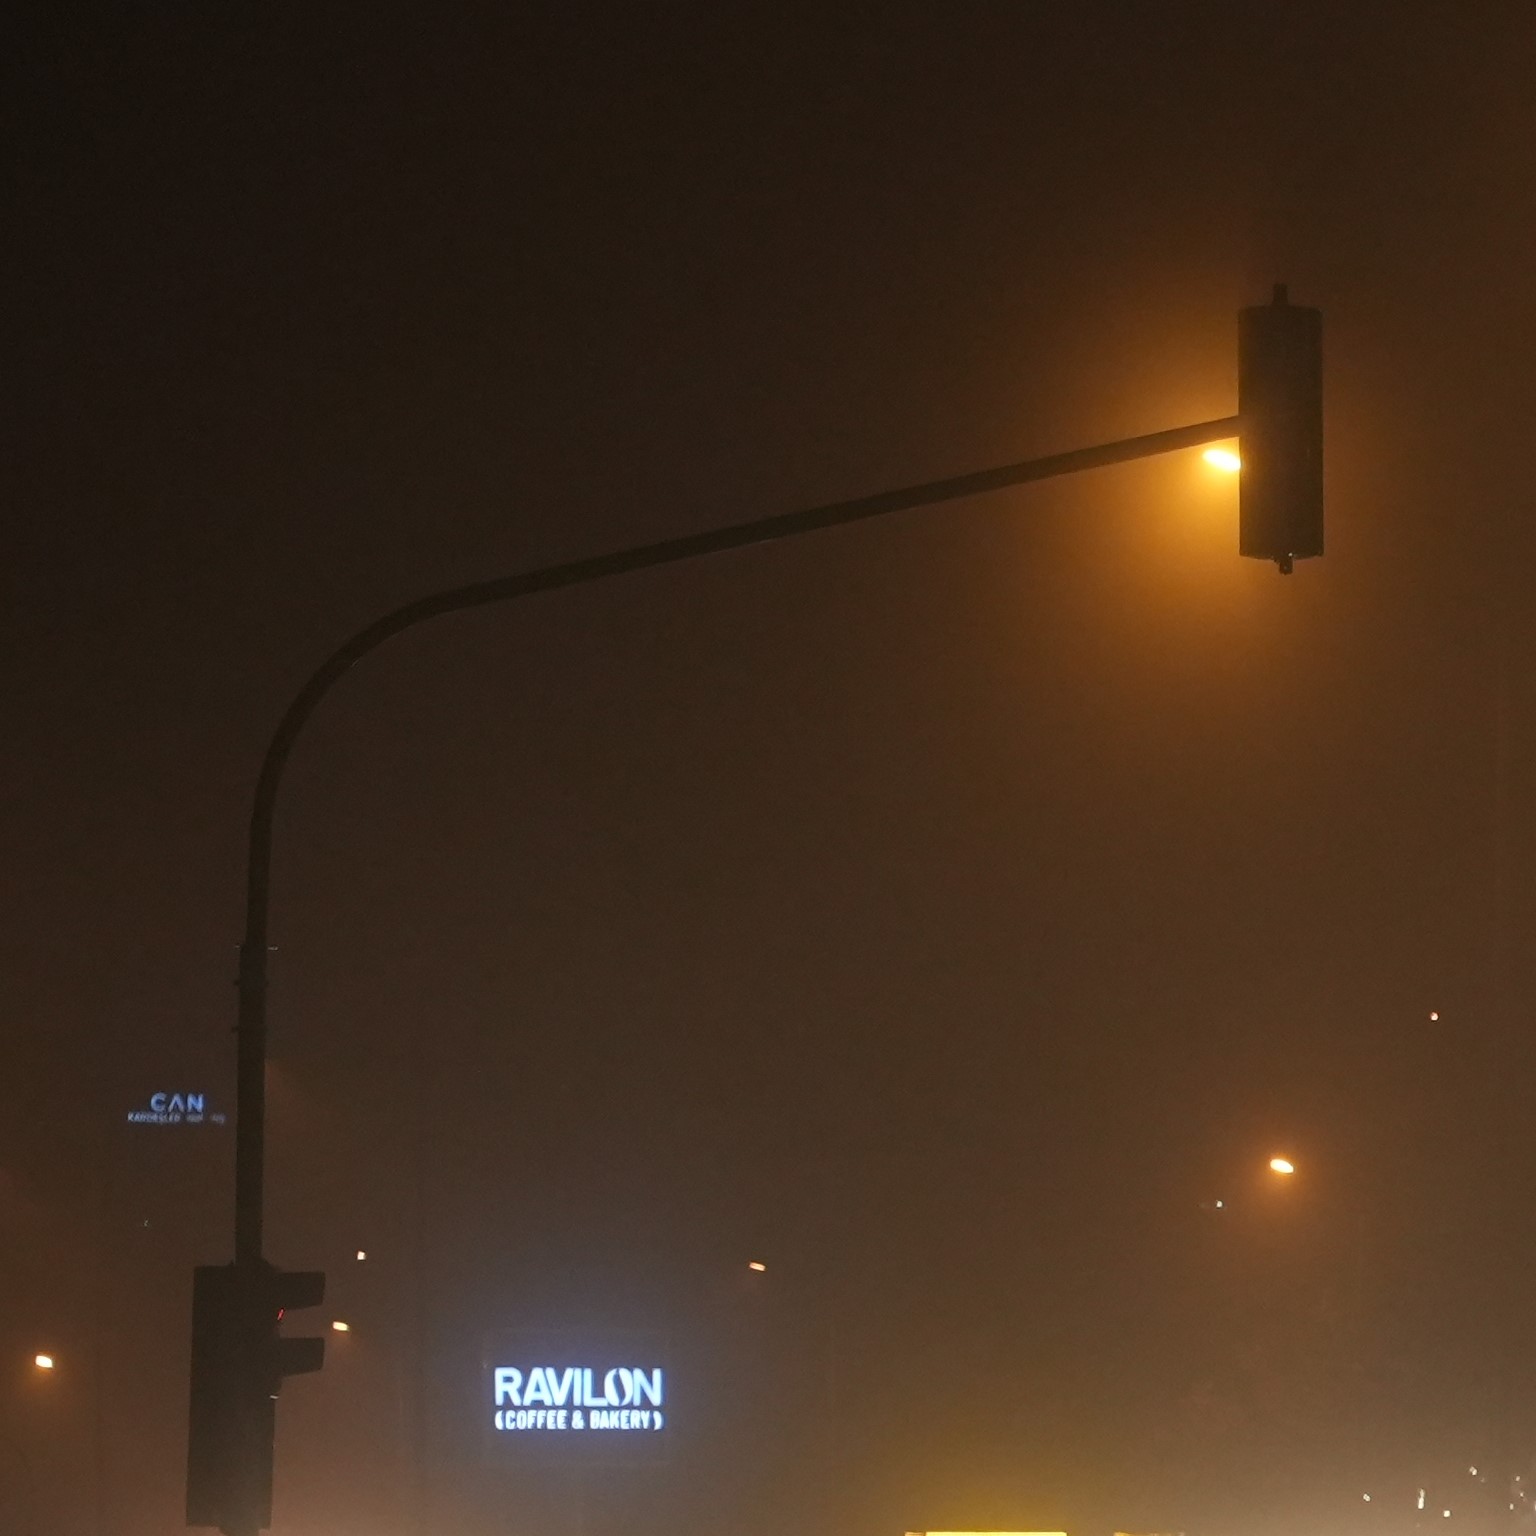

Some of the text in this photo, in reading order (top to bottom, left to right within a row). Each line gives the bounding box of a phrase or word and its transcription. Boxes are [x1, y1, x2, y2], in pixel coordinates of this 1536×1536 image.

[150, 1092, 204, 1113] CAN
[494, 1366, 662, 1407] RAVILON
[571, 1409, 585, 1430] &
